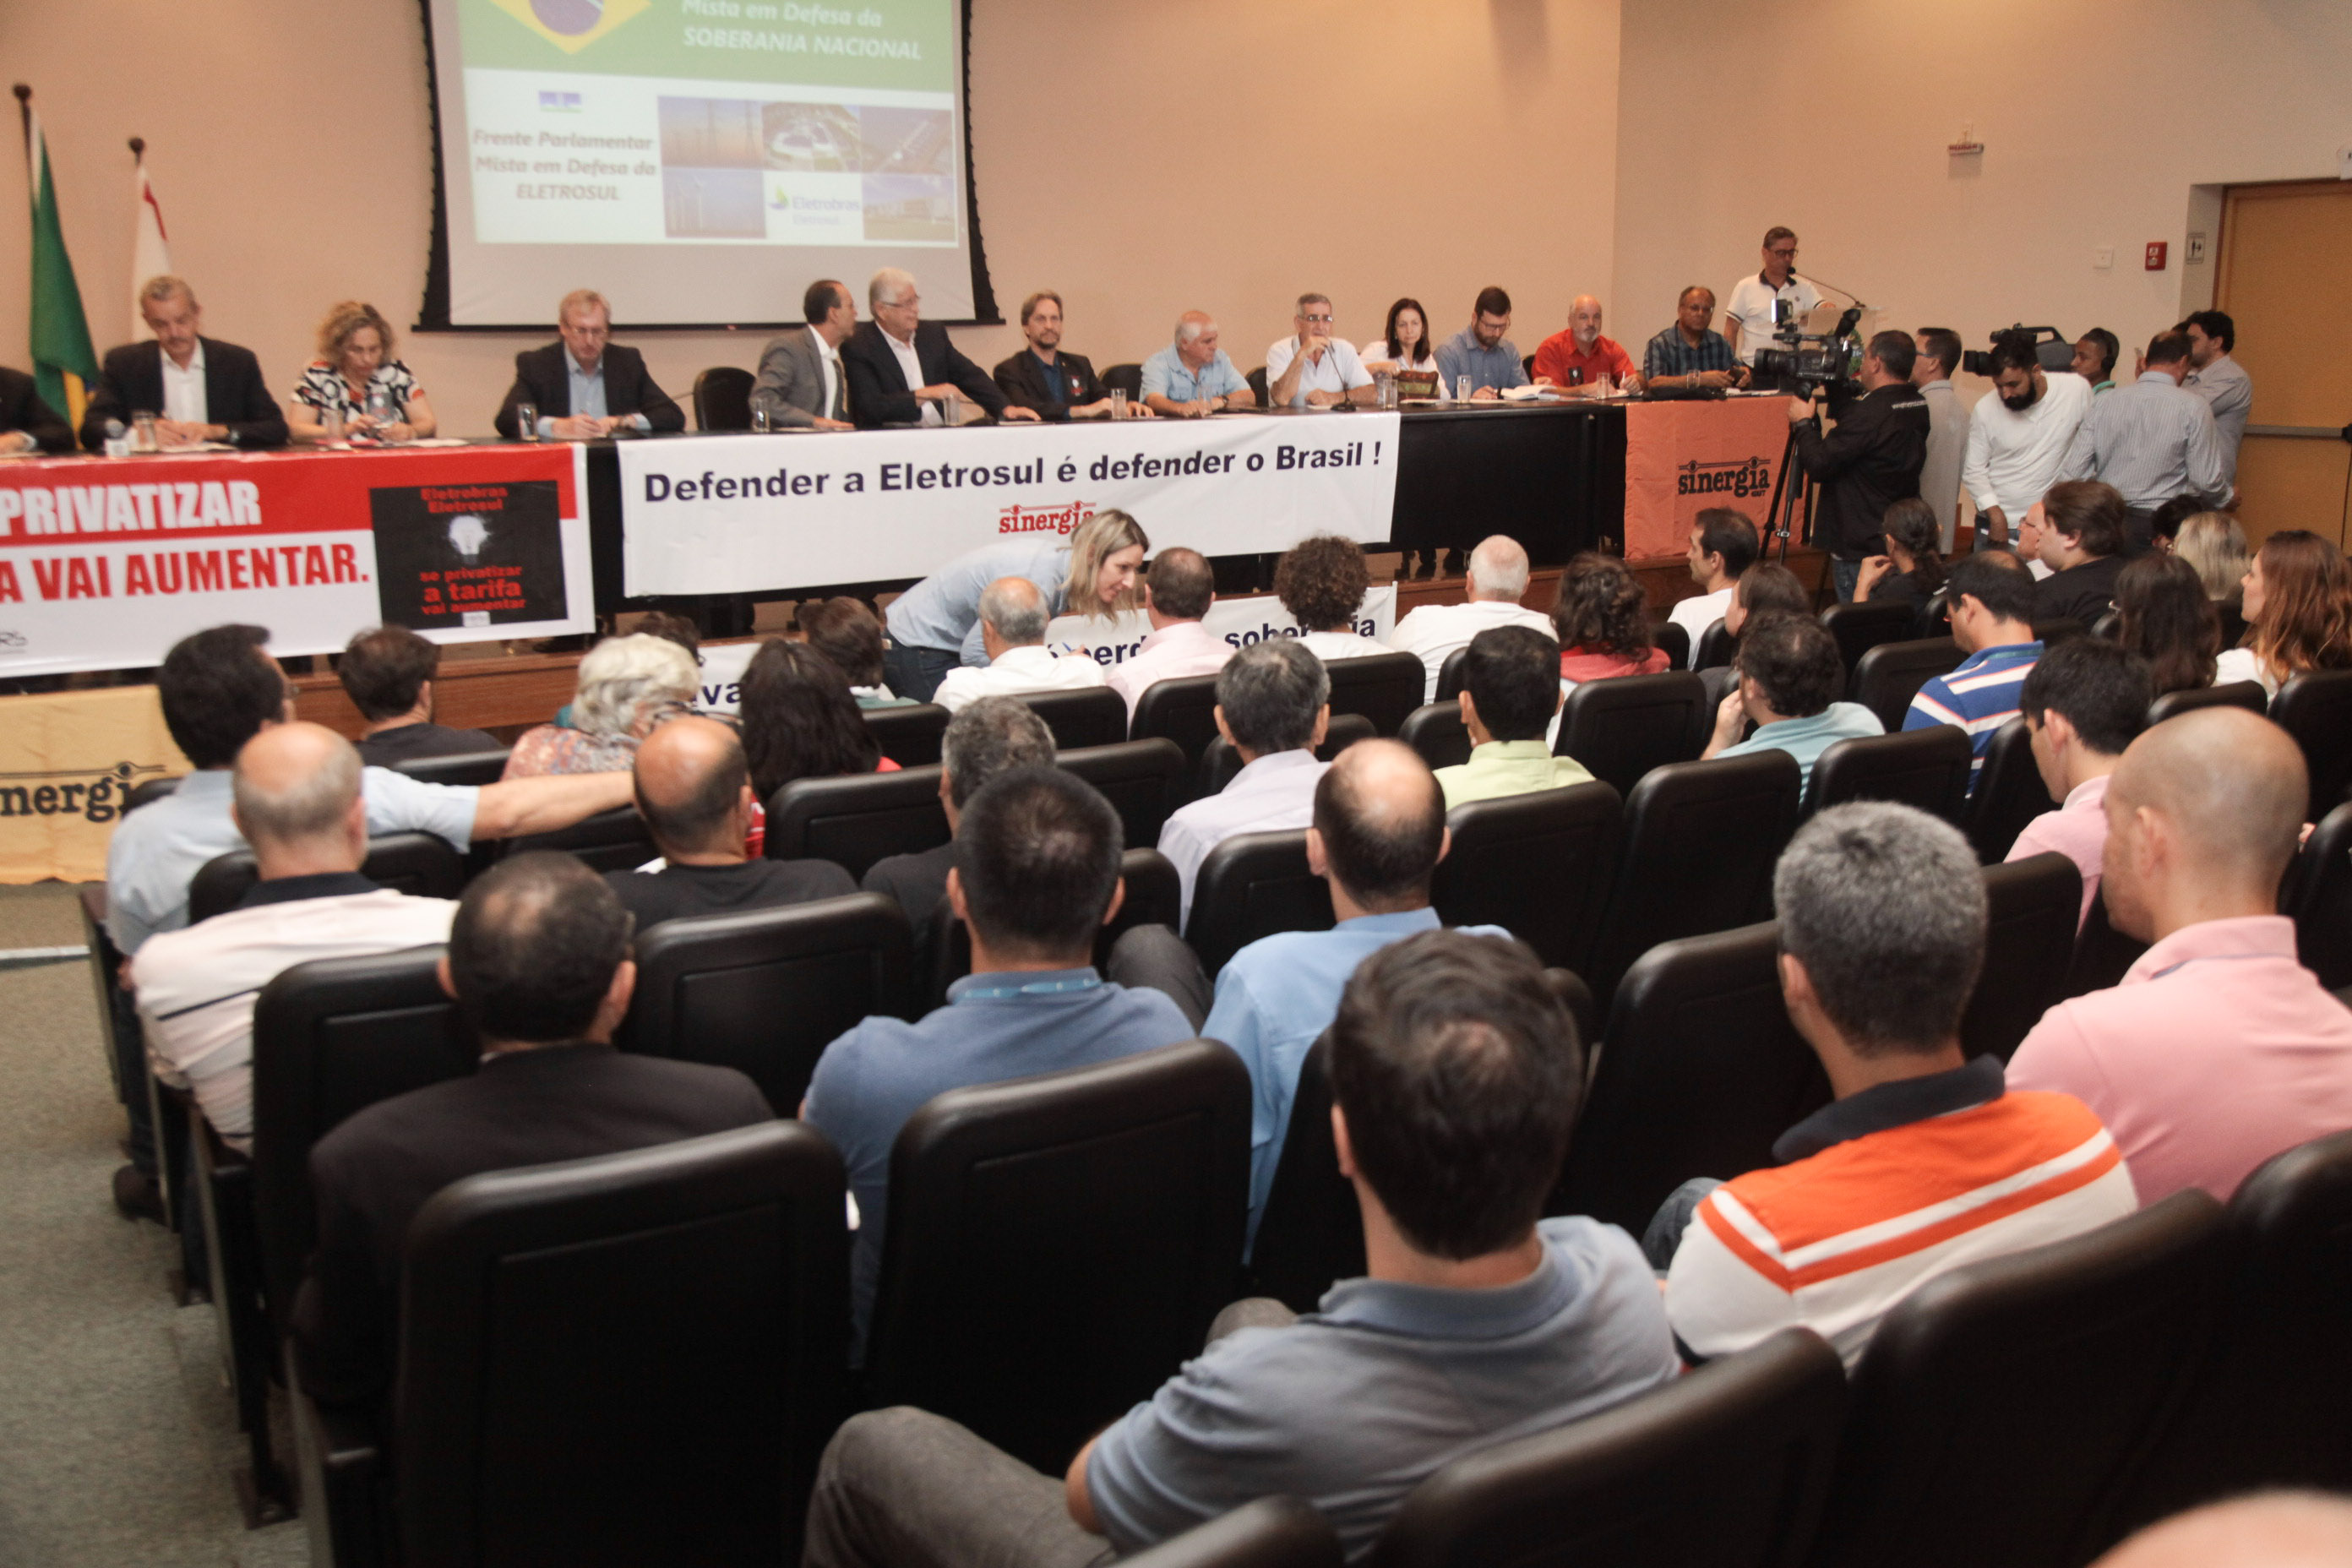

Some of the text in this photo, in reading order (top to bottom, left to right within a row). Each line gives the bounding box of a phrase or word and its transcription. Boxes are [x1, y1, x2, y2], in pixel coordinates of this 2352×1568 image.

[682, 0, 882, 27] Mista em Defesa da
[683, 27, 922, 60] SOBERANIA NACIONAL
[473, 128, 652, 150] Frente Parlamentar
[475, 156, 656, 177] Mista em Defesa da
[516, 184, 619, 200] ELETROSUL
[645, 468, 830, 502] Defender
[843, 471, 865, 493] a
[879, 457, 1043, 492] Eletrosul
[1057, 455, 1077, 482] é
[1089, 450, 1236, 482] defender
[1246, 453, 1265, 472] o
[1277, 442, 1363, 470] Brasil
[1678, 462, 1770, 498] sinergia
[0, 480, 262, 536] PRIVATIZAR
[31, 557, 112, 602] VAI
[125, 543, 370, 596] AUMENTAR.
[444, 566, 522, 583] privatizar
[424, 579, 521, 602] a tarifa
